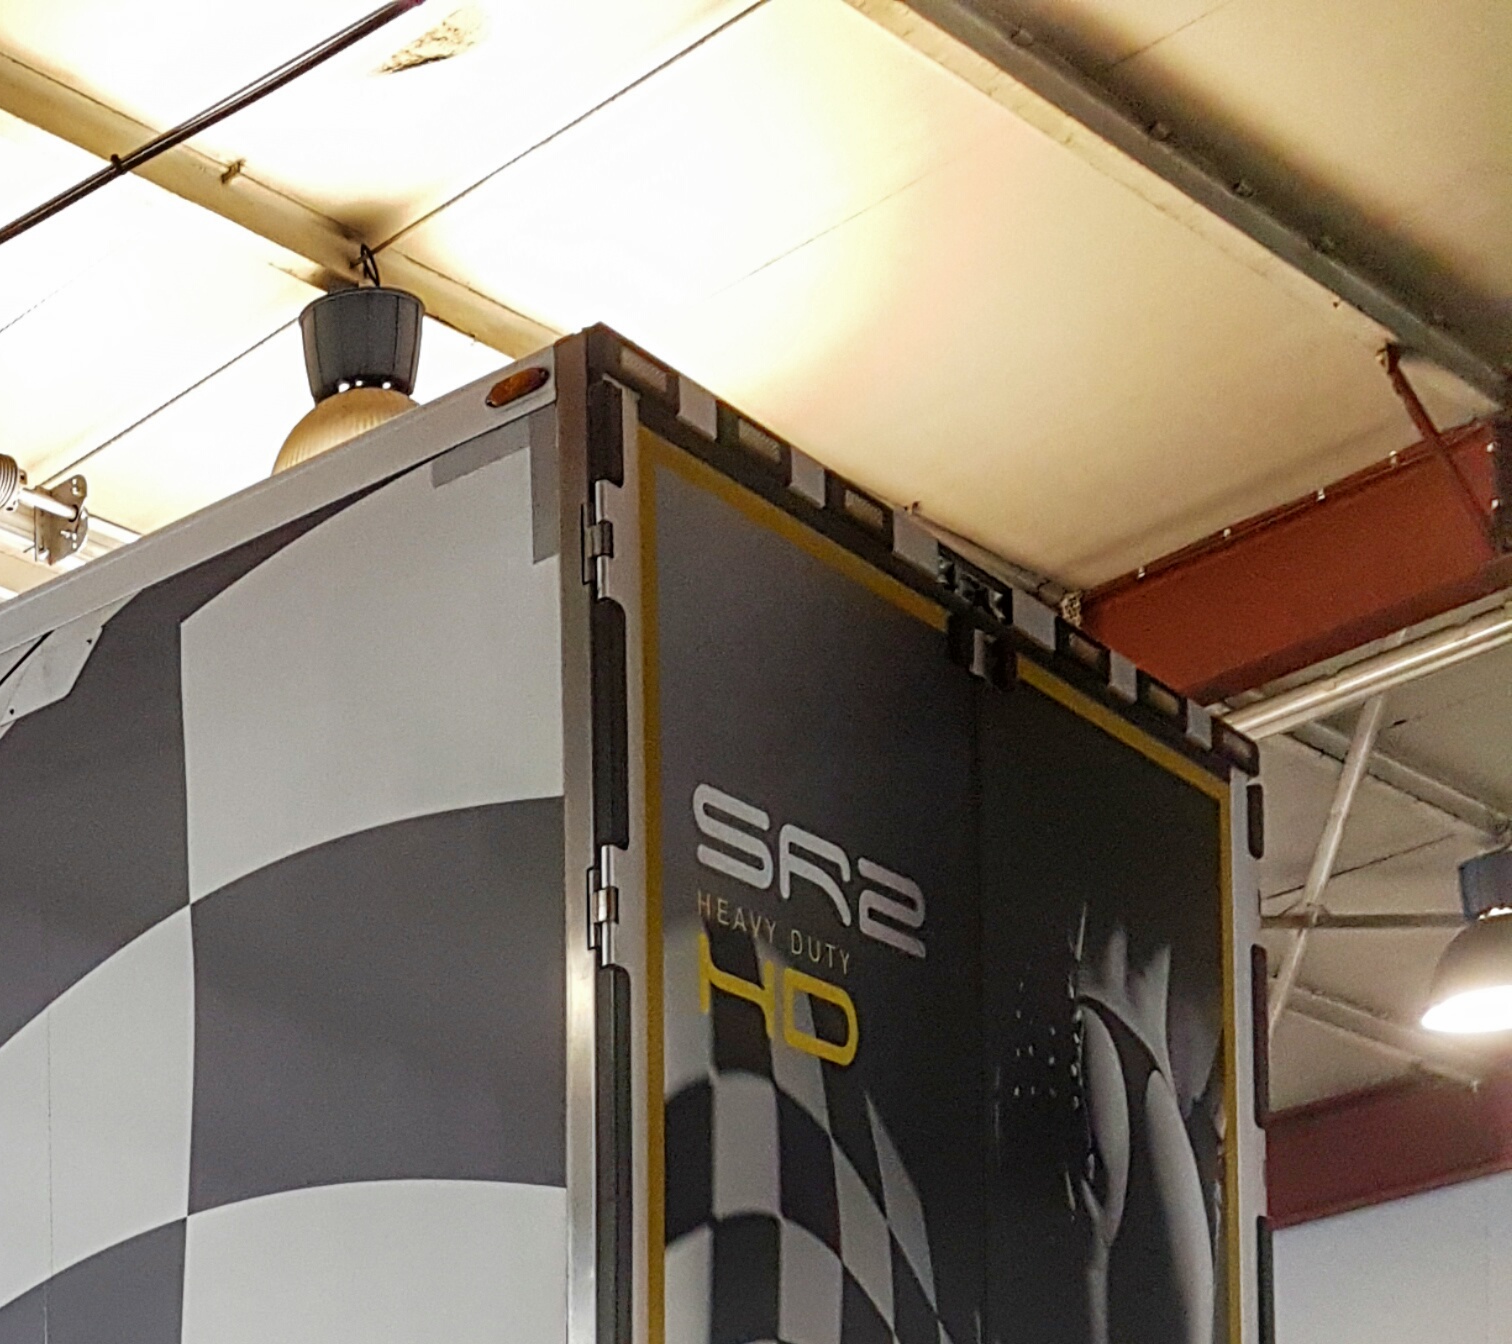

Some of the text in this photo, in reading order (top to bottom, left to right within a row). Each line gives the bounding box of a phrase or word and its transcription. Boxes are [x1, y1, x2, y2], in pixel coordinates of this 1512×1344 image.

[693, 783, 926, 959] SR2
[697, 889, 850, 975] HEAVY DUTY
[699, 930, 859, 1066] HD
